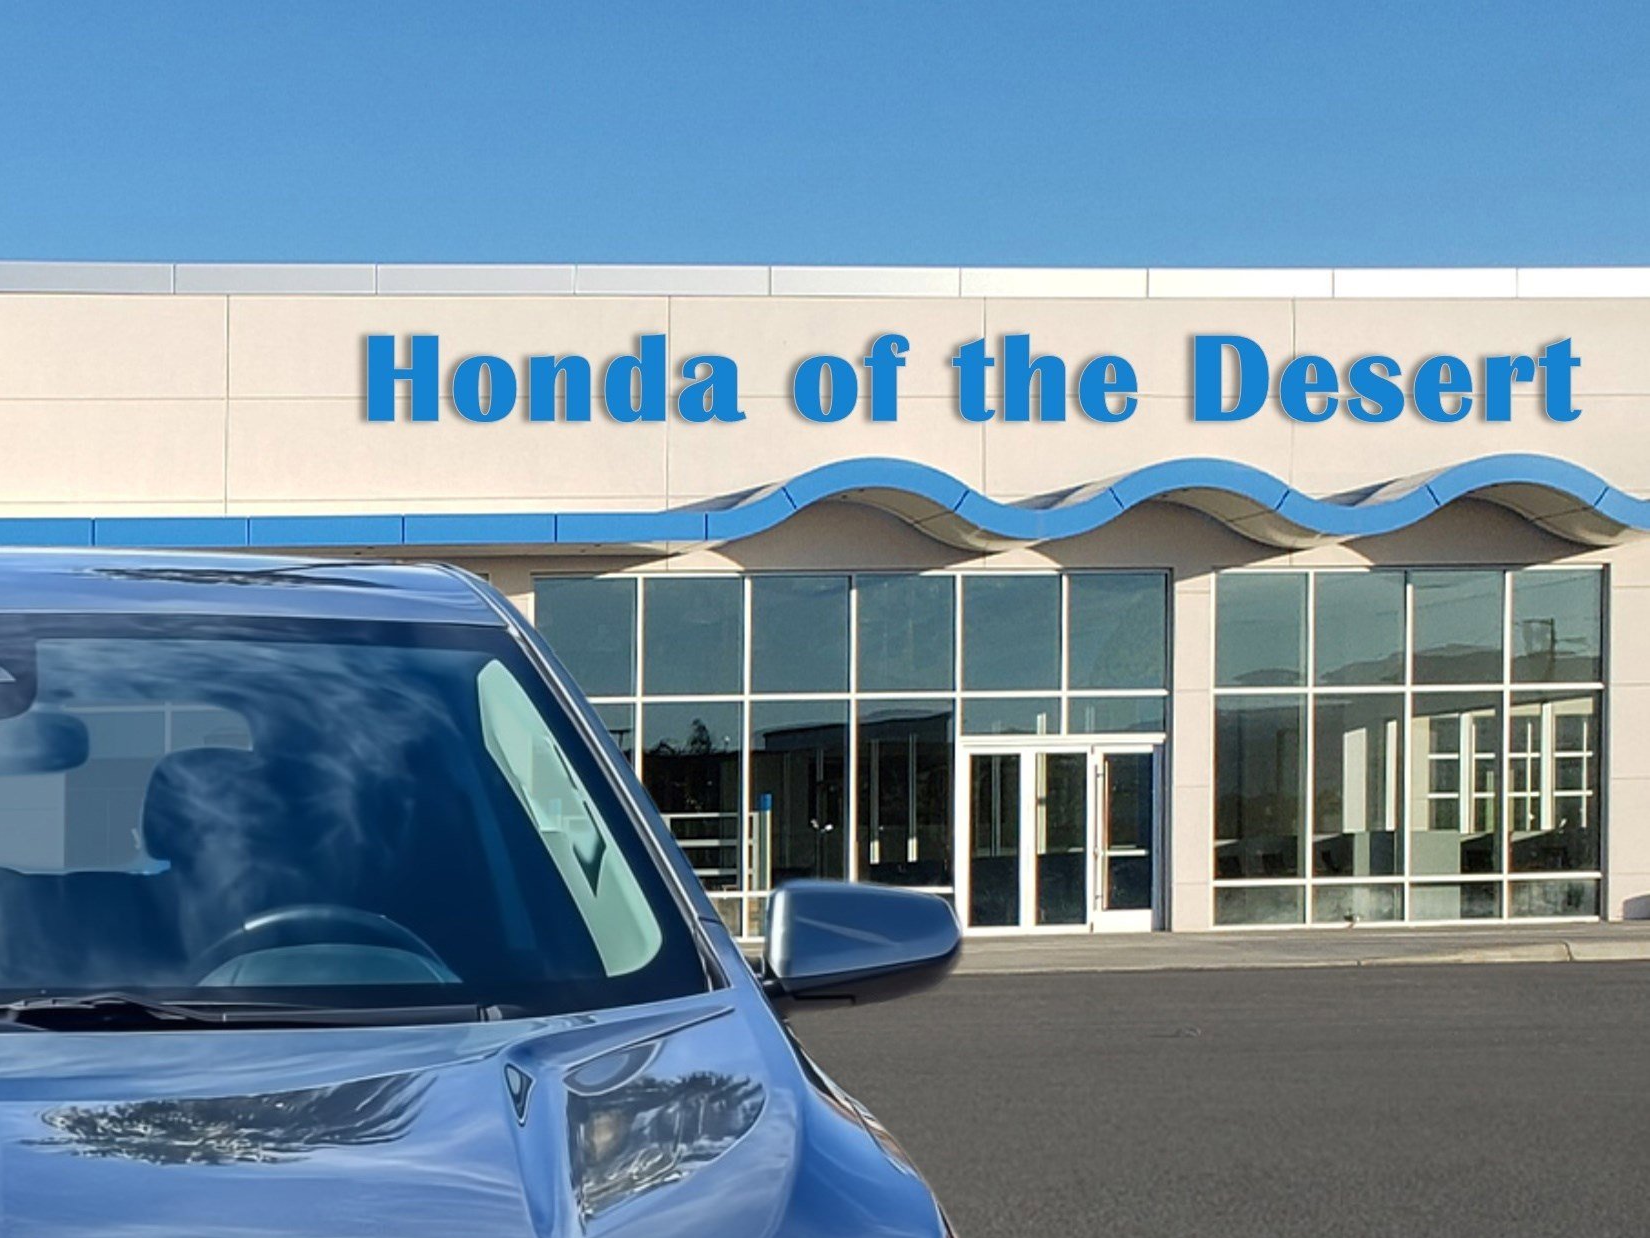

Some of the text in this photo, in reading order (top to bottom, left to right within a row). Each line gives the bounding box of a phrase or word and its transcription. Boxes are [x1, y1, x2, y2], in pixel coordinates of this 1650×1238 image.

[367, 334, 1582, 423] Honda of the Desert
